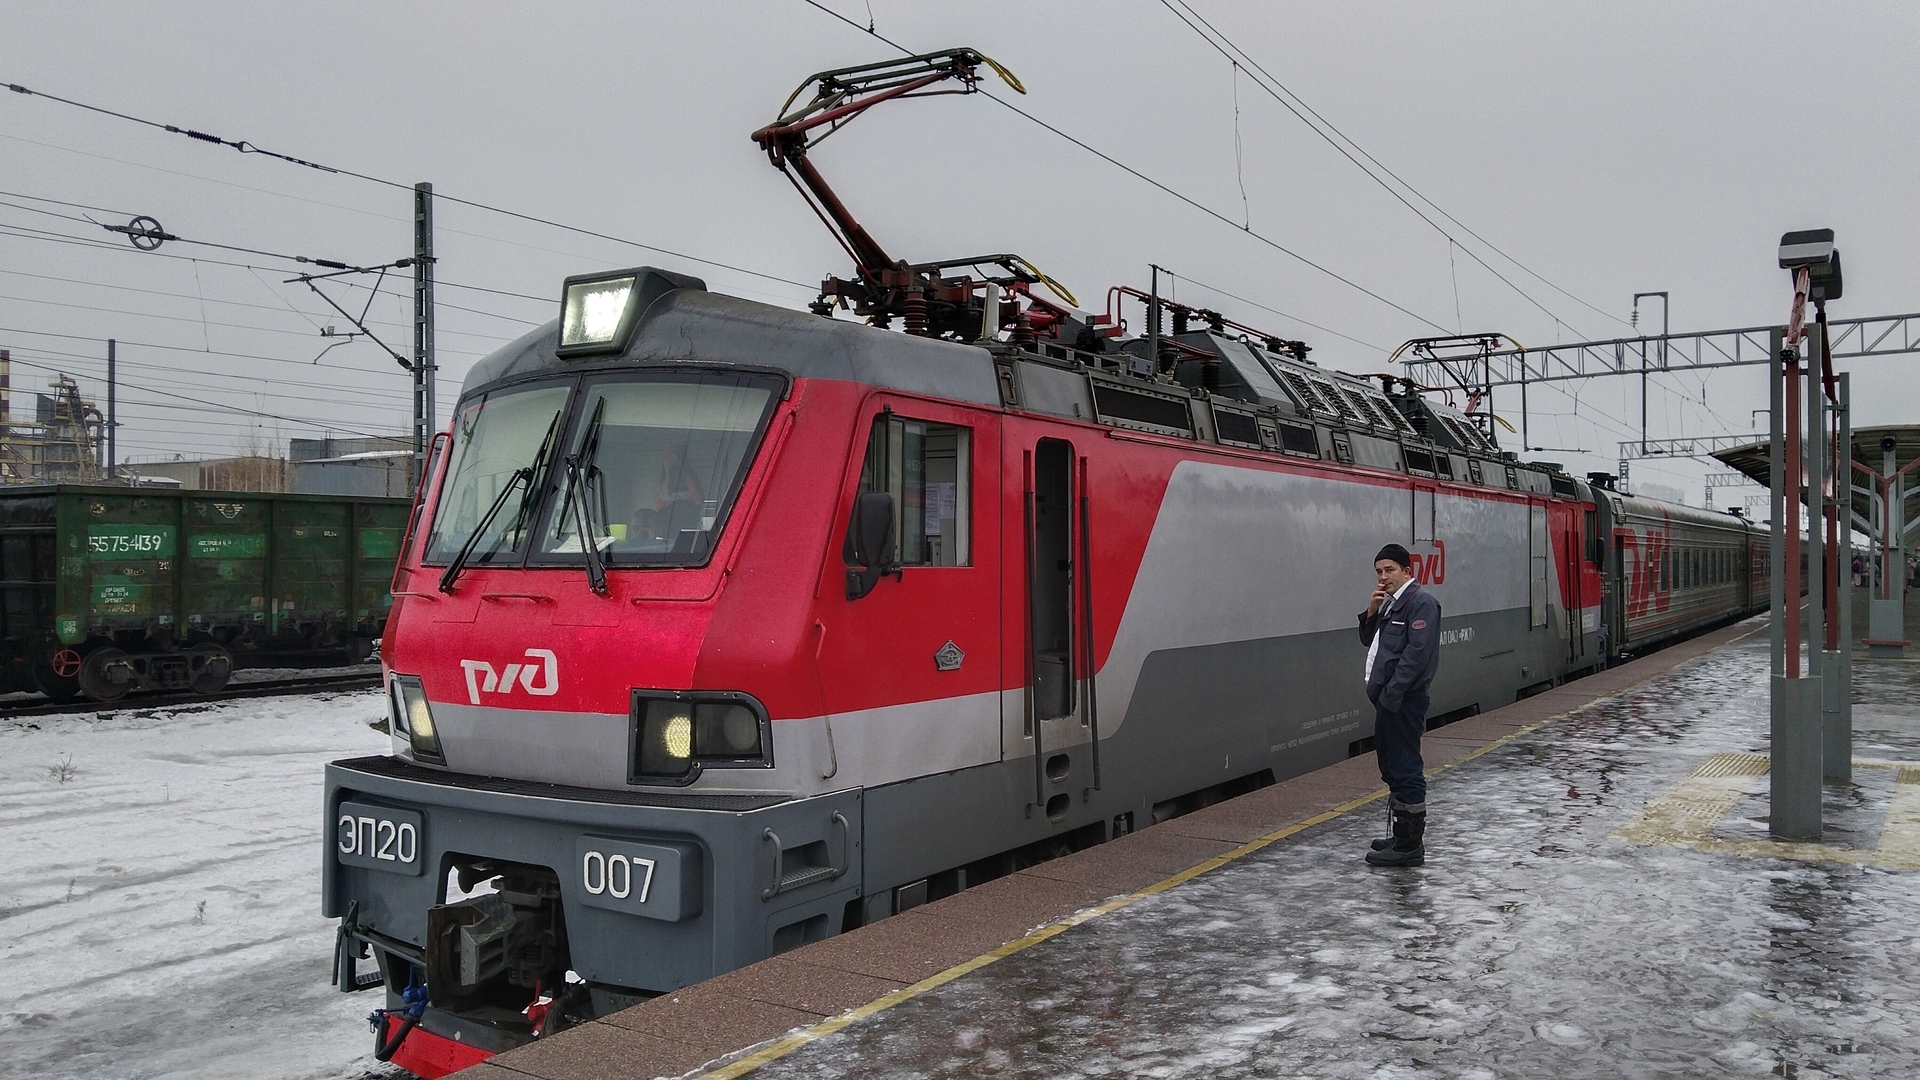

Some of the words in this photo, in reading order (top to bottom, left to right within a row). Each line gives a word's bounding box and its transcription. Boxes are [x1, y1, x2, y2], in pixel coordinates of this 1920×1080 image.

[88, 534, 162, 552] 55754139
[460, 648, 559, 704] РЖД
[338, 815, 417, 864] ЭП20
[583, 850, 656, 903] 007
